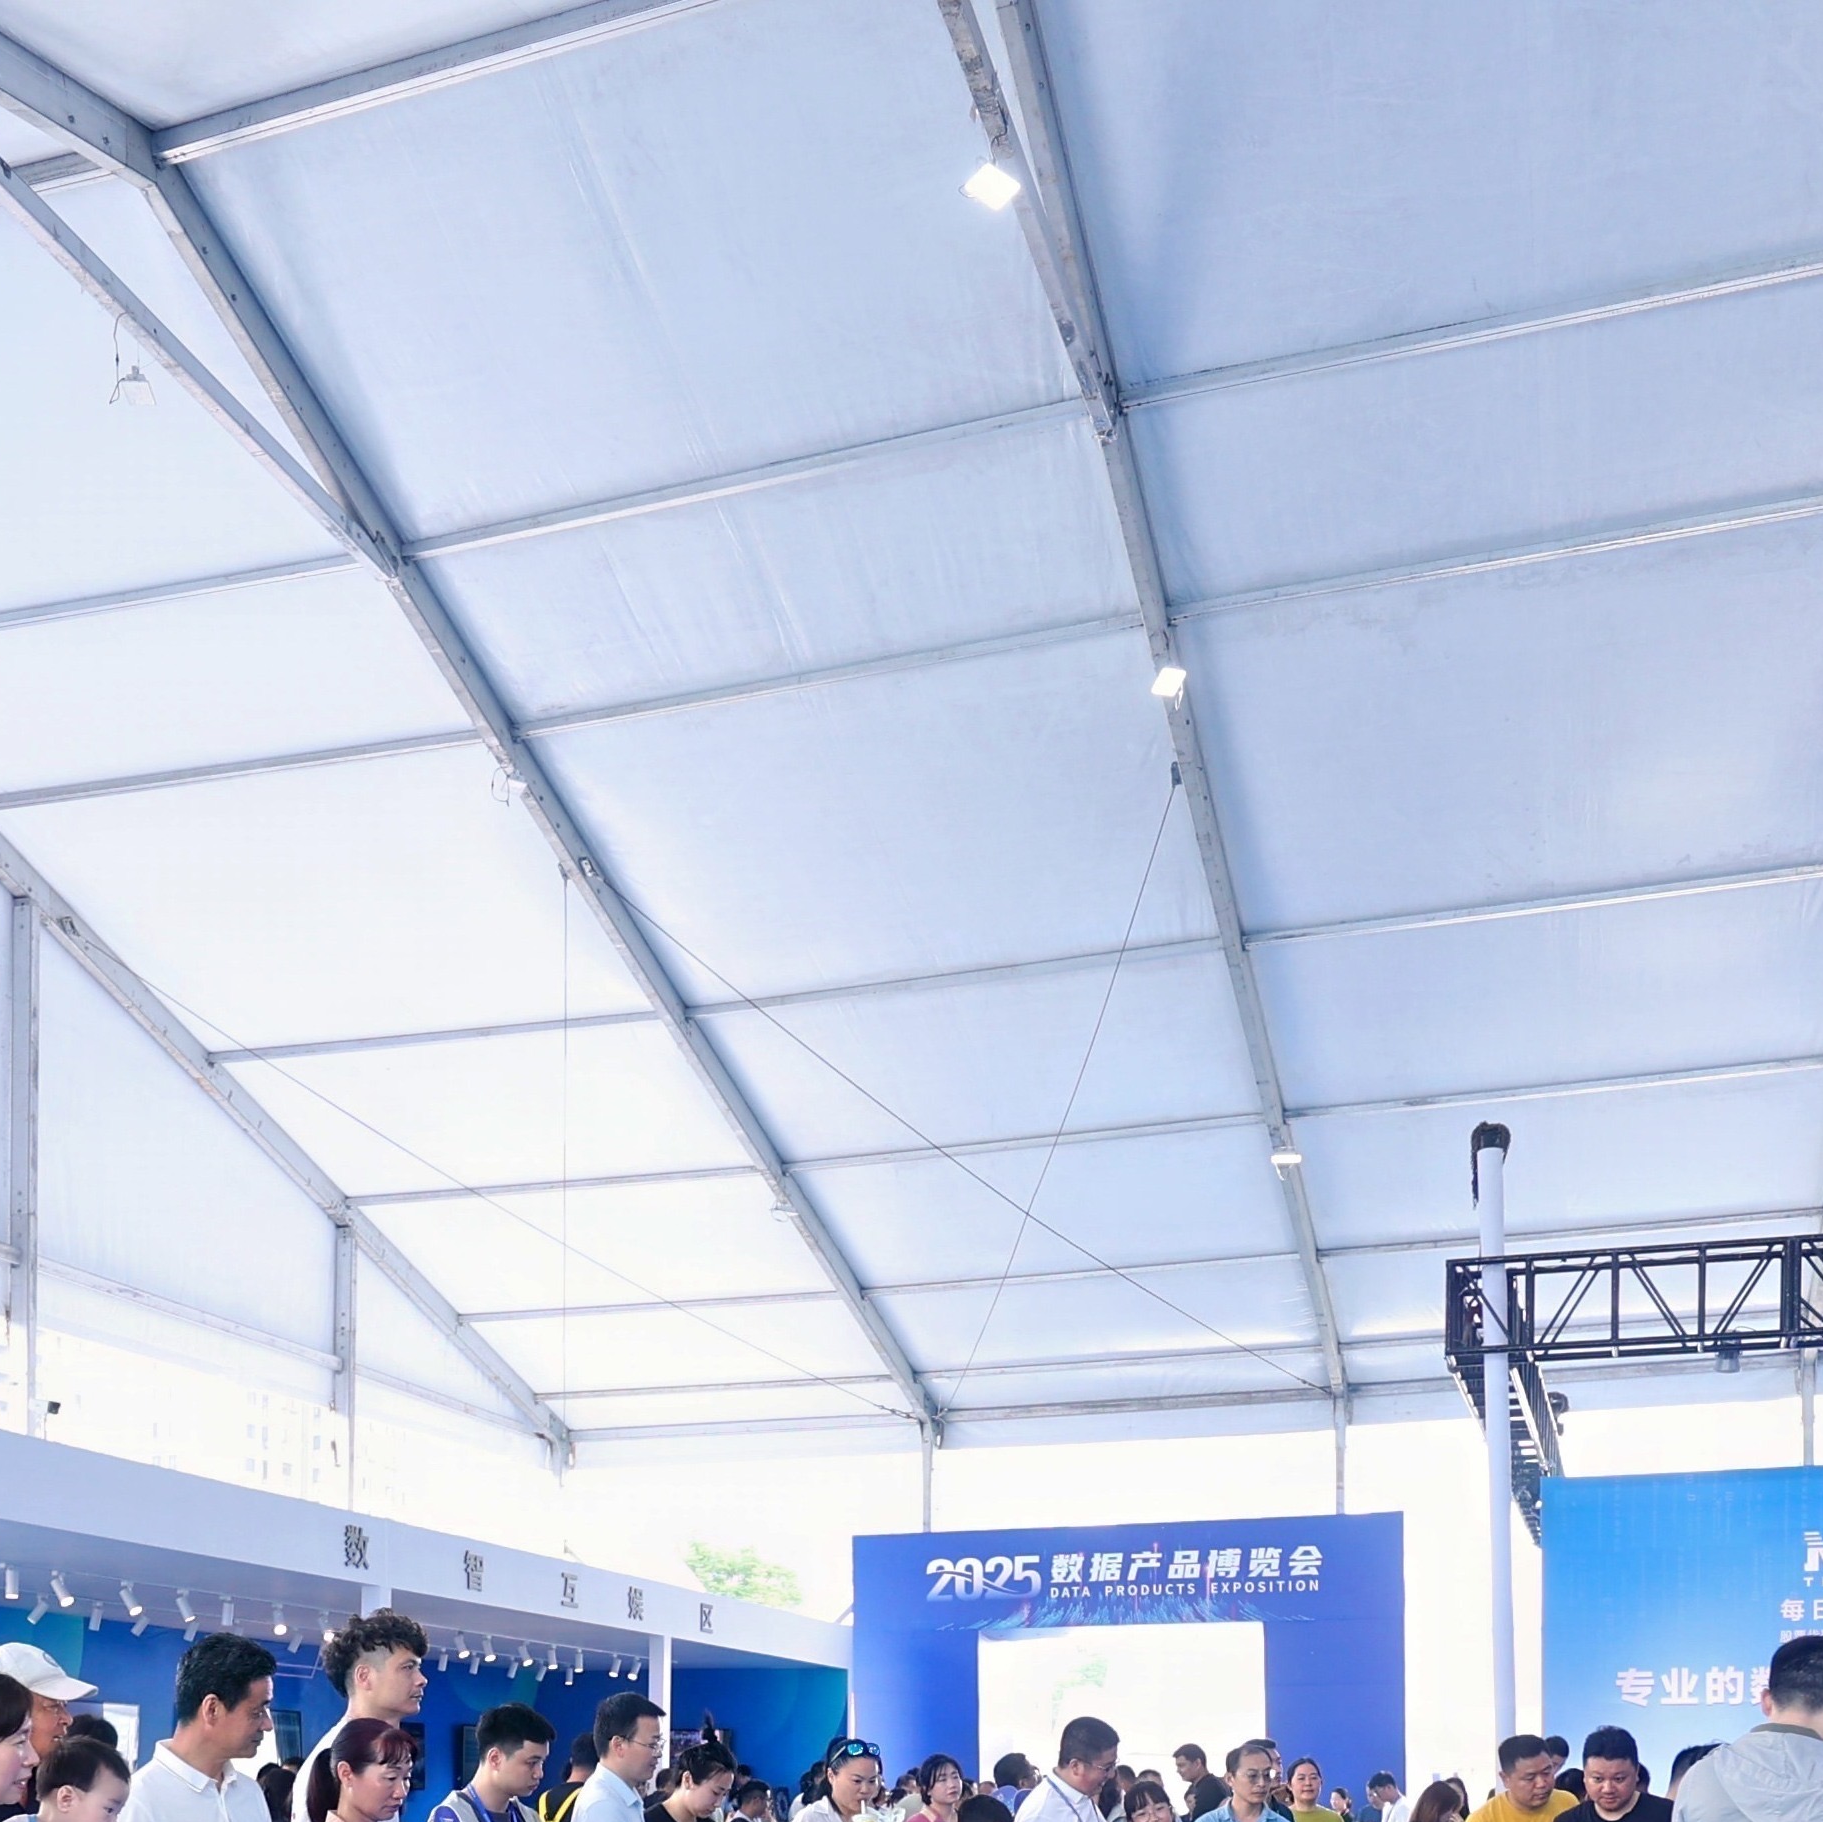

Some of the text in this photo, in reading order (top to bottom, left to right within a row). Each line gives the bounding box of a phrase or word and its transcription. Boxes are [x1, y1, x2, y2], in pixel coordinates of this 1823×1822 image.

[344, 1524, 714, 1633] 数智互娱区
[926, 1545, 1324, 1601] 2025 数据产品博览会
[1050, 1579, 1320, 1598] DATA PRODUCTS EXPOSITION
